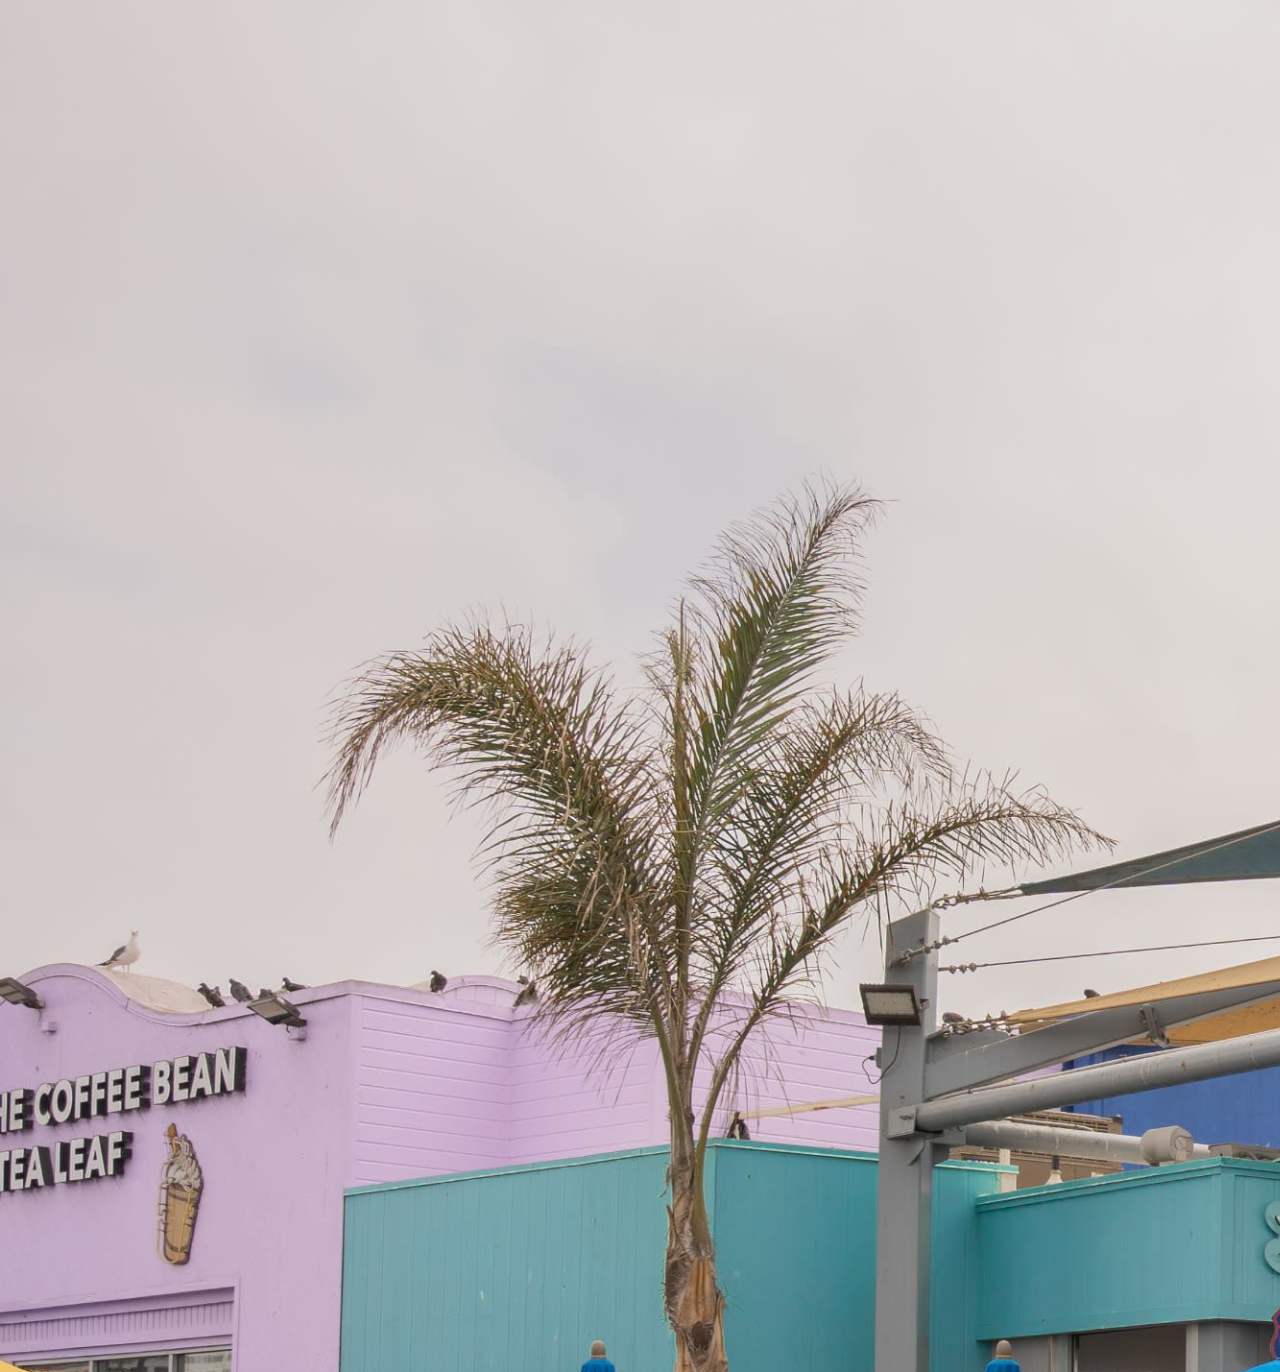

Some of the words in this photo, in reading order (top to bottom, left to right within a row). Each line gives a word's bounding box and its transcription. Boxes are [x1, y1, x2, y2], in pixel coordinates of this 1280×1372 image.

[34, 1066, 142, 1126] COFFEE
[153, 1047, 237, 1105] BEAN
[0, 1147, 45, 1191] TEA
[54, 1131, 124, 1184] LEAF
